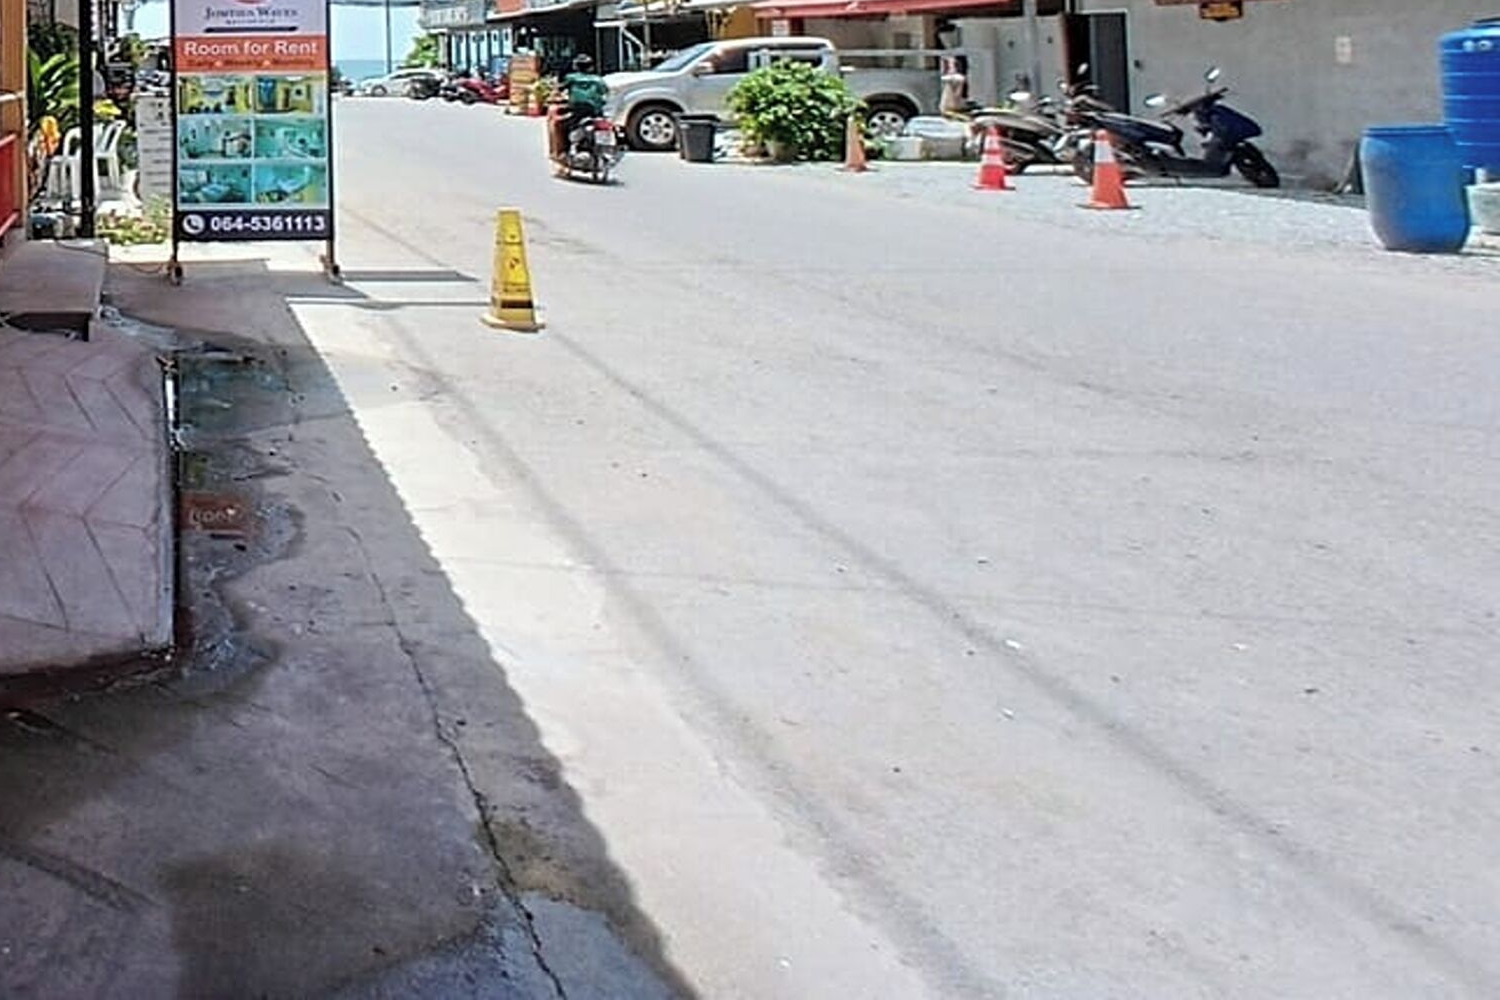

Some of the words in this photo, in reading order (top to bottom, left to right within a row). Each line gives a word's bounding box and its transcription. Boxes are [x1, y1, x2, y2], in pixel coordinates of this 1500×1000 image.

[184, 41, 240, 56] Room
[243, 40, 269, 55] for
[274, 39, 318, 55] Rent
